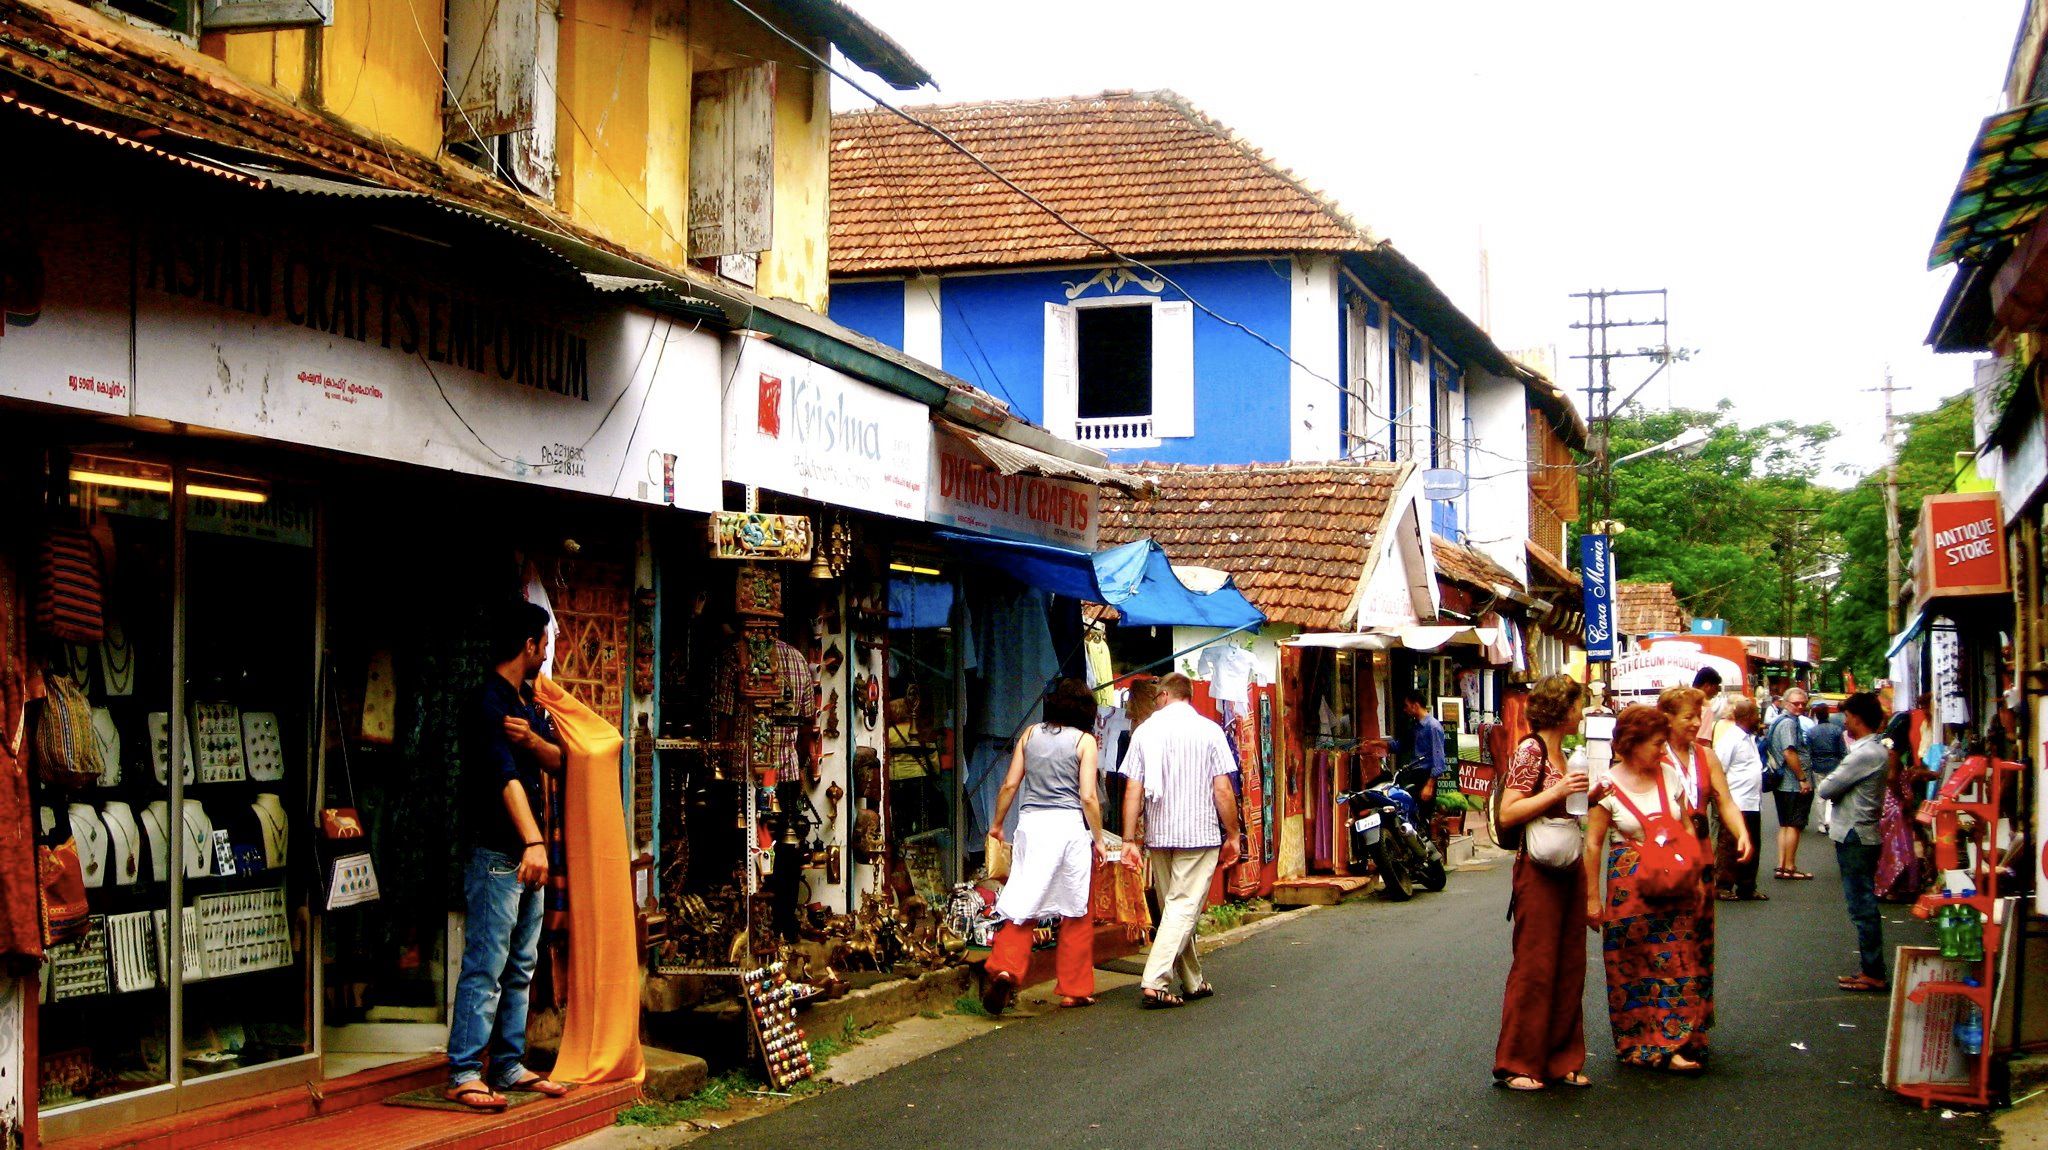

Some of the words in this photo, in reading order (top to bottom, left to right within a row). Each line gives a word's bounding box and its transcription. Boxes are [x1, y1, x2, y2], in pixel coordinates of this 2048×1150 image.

[146, 231, 271, 317] ASIAN
[284, 252, 420, 352] CRAFTS
[428, 289, 589, 402] EMPORIUM
[790, 376, 881, 461] Krishna
[940, 452, 1024, 515] DYNASTY
[1027, 479, 1088, 531] CRAFTS
[1935, 517, 1996, 549] ANTIQUE
[1945, 538, 1994, 566] STORE
[1586, 539, 1606, 598] Maria
[1667, 655, 1705, 673] PRODUC
[1458, 764, 1478, 778] ART
[1459, 777, 1490, 792] ALLERY
